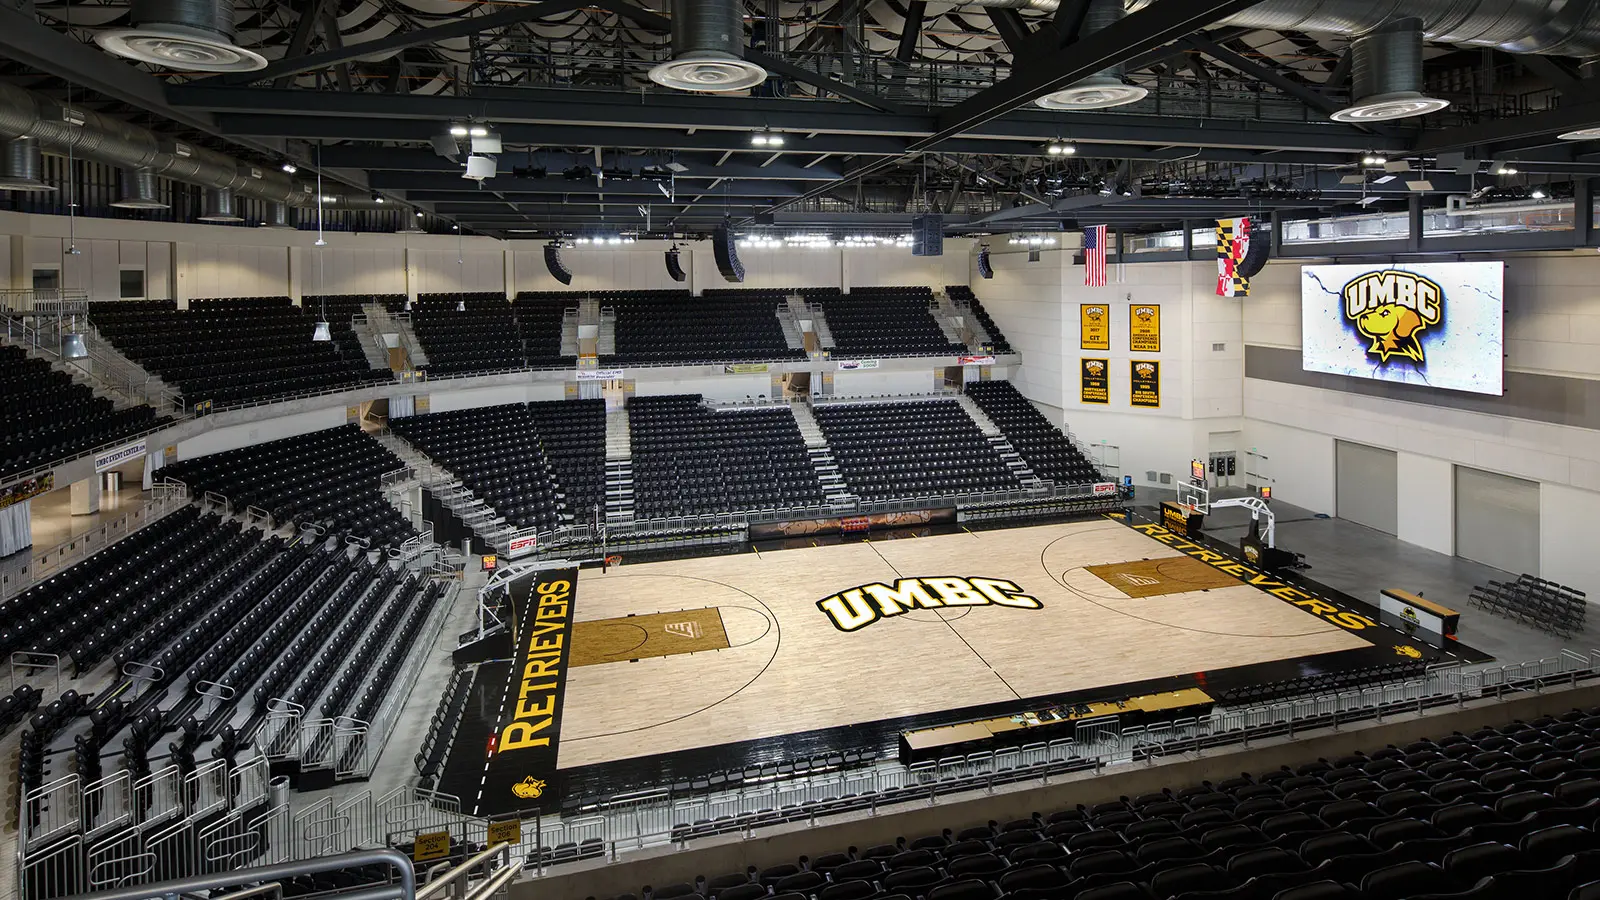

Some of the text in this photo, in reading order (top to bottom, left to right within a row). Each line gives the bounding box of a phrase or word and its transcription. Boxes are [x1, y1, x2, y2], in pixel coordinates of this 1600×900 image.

[1346, 273, 1439, 321] UMBC
[1086, 307, 1104, 315] UMBC
[1136, 307, 1155, 316] UMBC
[1086, 361, 1104, 369] UMBC
[1136, 363, 1155, 372] UMBC
[109, 452, 123, 462] EVENT
[1164, 507, 1187, 521] UMBC
[511, 538, 536, 550] ESPN
[1132, 523, 1378, 630] RETRIEVERS
[816, 576, 1044, 632] UMBC
[498, 580, 571, 754] RETRIEVERS
[490, 823, 518, 834] Section
[418, 835, 446, 844] Section
